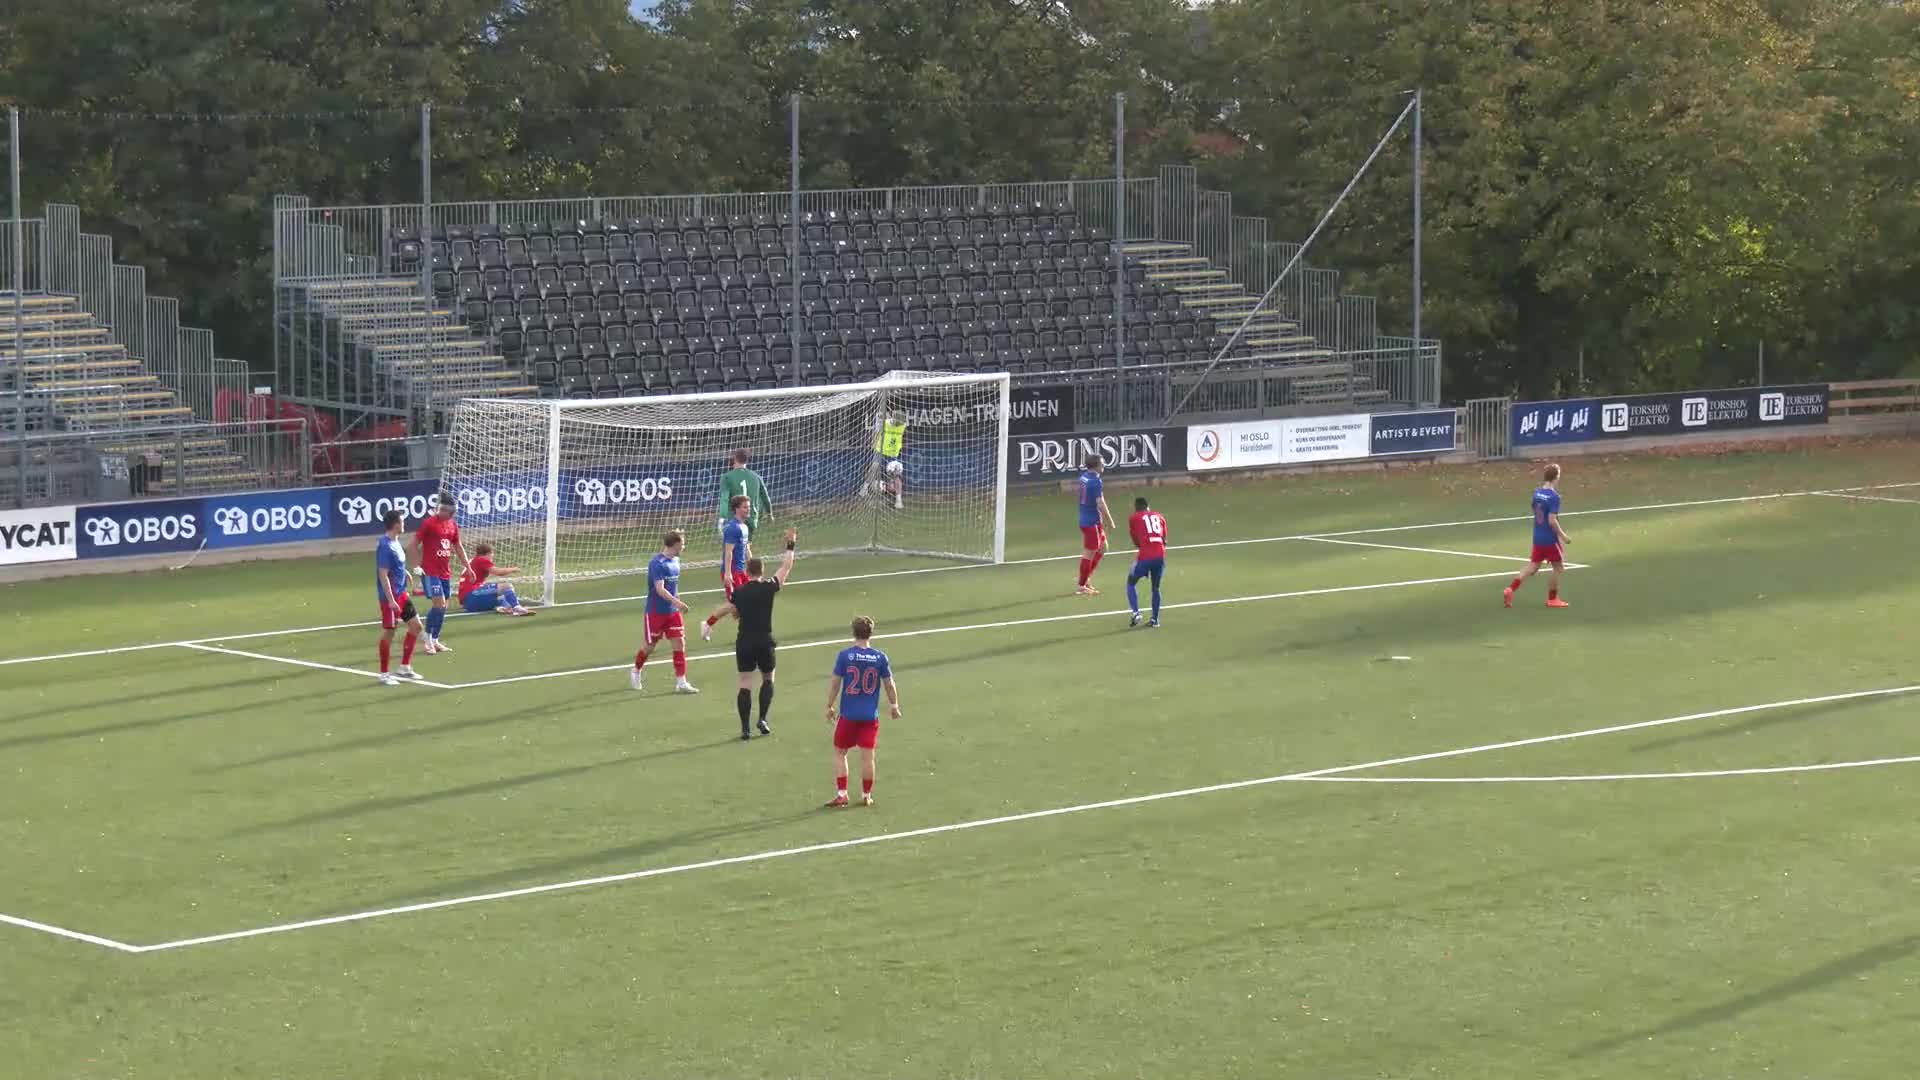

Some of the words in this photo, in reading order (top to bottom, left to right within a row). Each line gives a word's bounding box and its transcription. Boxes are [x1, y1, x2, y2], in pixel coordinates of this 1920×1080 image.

[1709, 399, 1748, 410] TORSHOV
[1787, 394, 1824, 405] TORSHOV
[1631, 404, 1670, 416] TORSHOV
[1708, 410, 1748, 421] ELEKTRO
[1785, 404, 1824, 416] ELEKTRO
[1630, 414, 1670, 427] ELEKTRO
[1240, 434, 1249, 442] HI
[1249, 432, 1269, 442] OSLO
[1375, 428, 1410, 440] ARTIST
[1411, 427, 1418, 437] &
[1419, 425, 1451, 437] EVENT
[1018, 432, 1163, 474] PRINSEN
[609, 477, 671, 502] OBOS
[740, 479, 748, 496] 1
[252, 504, 322, 532] OBOS
[1142, 514, 1162, 534] 18
[124, 514, 197, 543] OBOS
[846, 665, 878, 695] 20
